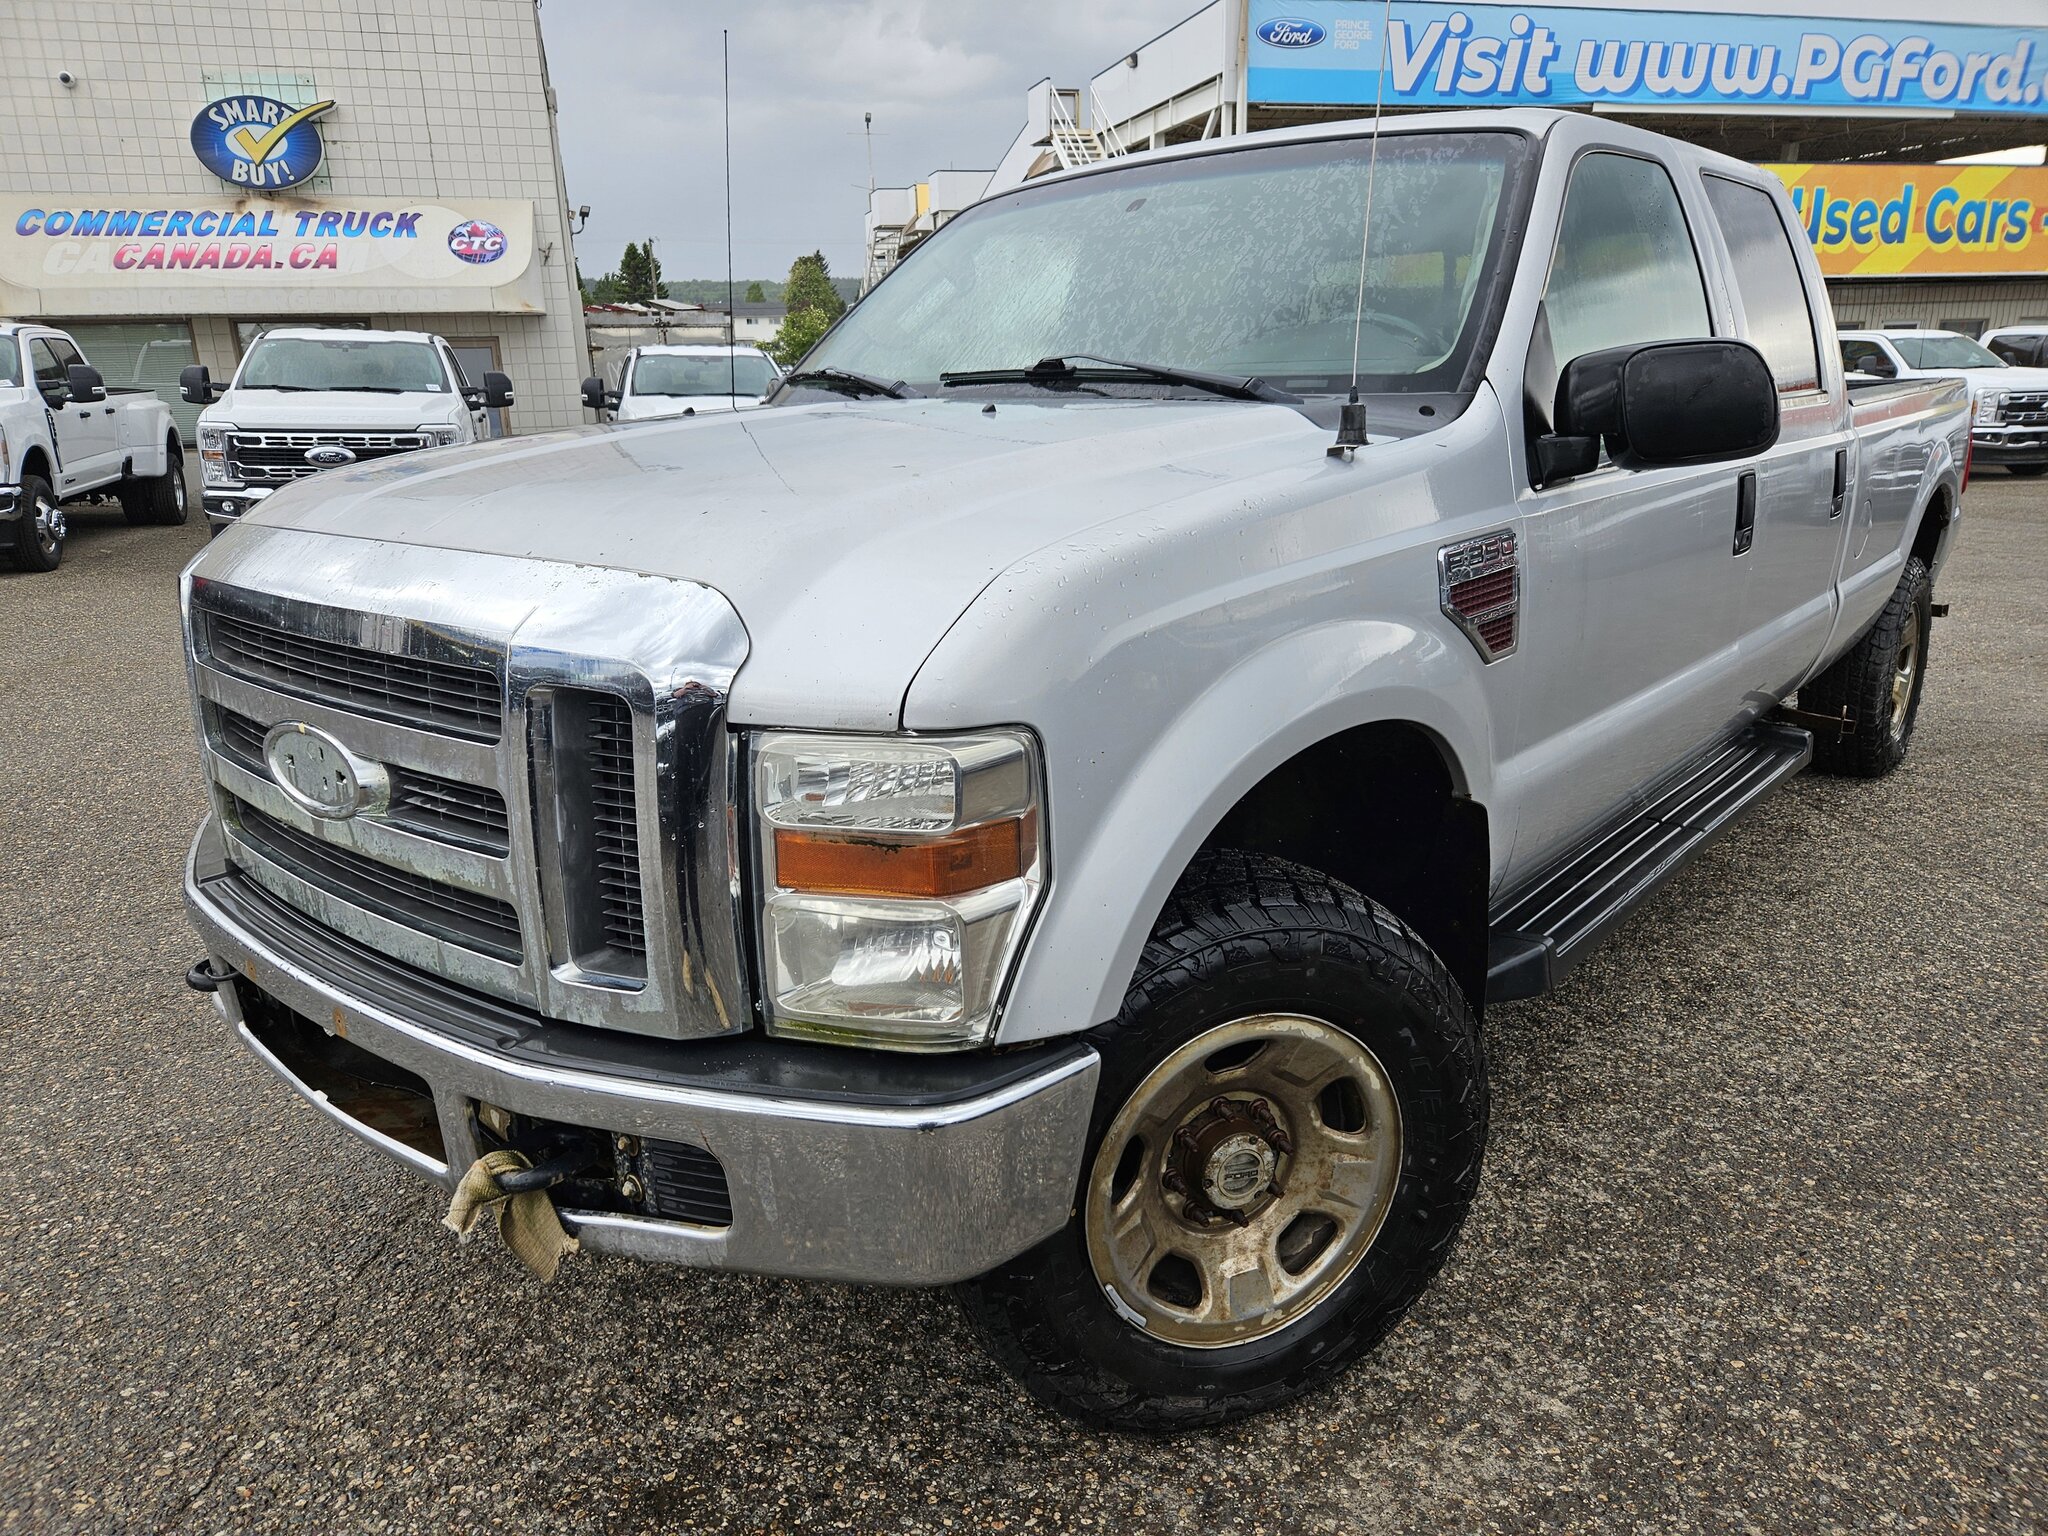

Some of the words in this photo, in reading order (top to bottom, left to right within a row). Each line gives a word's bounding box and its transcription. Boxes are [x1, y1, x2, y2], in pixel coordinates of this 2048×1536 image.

[1270, 21, 1313, 44] Ford
[1334, 30, 1373, 40] GEORGE
[1335, 20, 1370, 30] PRINCE
[1334, 40, 1359, 50] FORD
[1386, 11, 1557, 95] Visit
[1574, 32, 2048, 106] www.PGFord.
[208, 99, 294, 131] SMART
[231, 159, 295, 185] BUY!
[15, 208, 279, 237] COMMERCIAL
[295, 210, 423, 238] TRUCK
[1924, 186, 2032, 246] Cars
[451, 236, 503, 251] CTC
[112, 242, 338, 270] CANADA.CA
[318, 452, 343, 463] Ford
[1224, 1169, 1259, 1181] FORD
